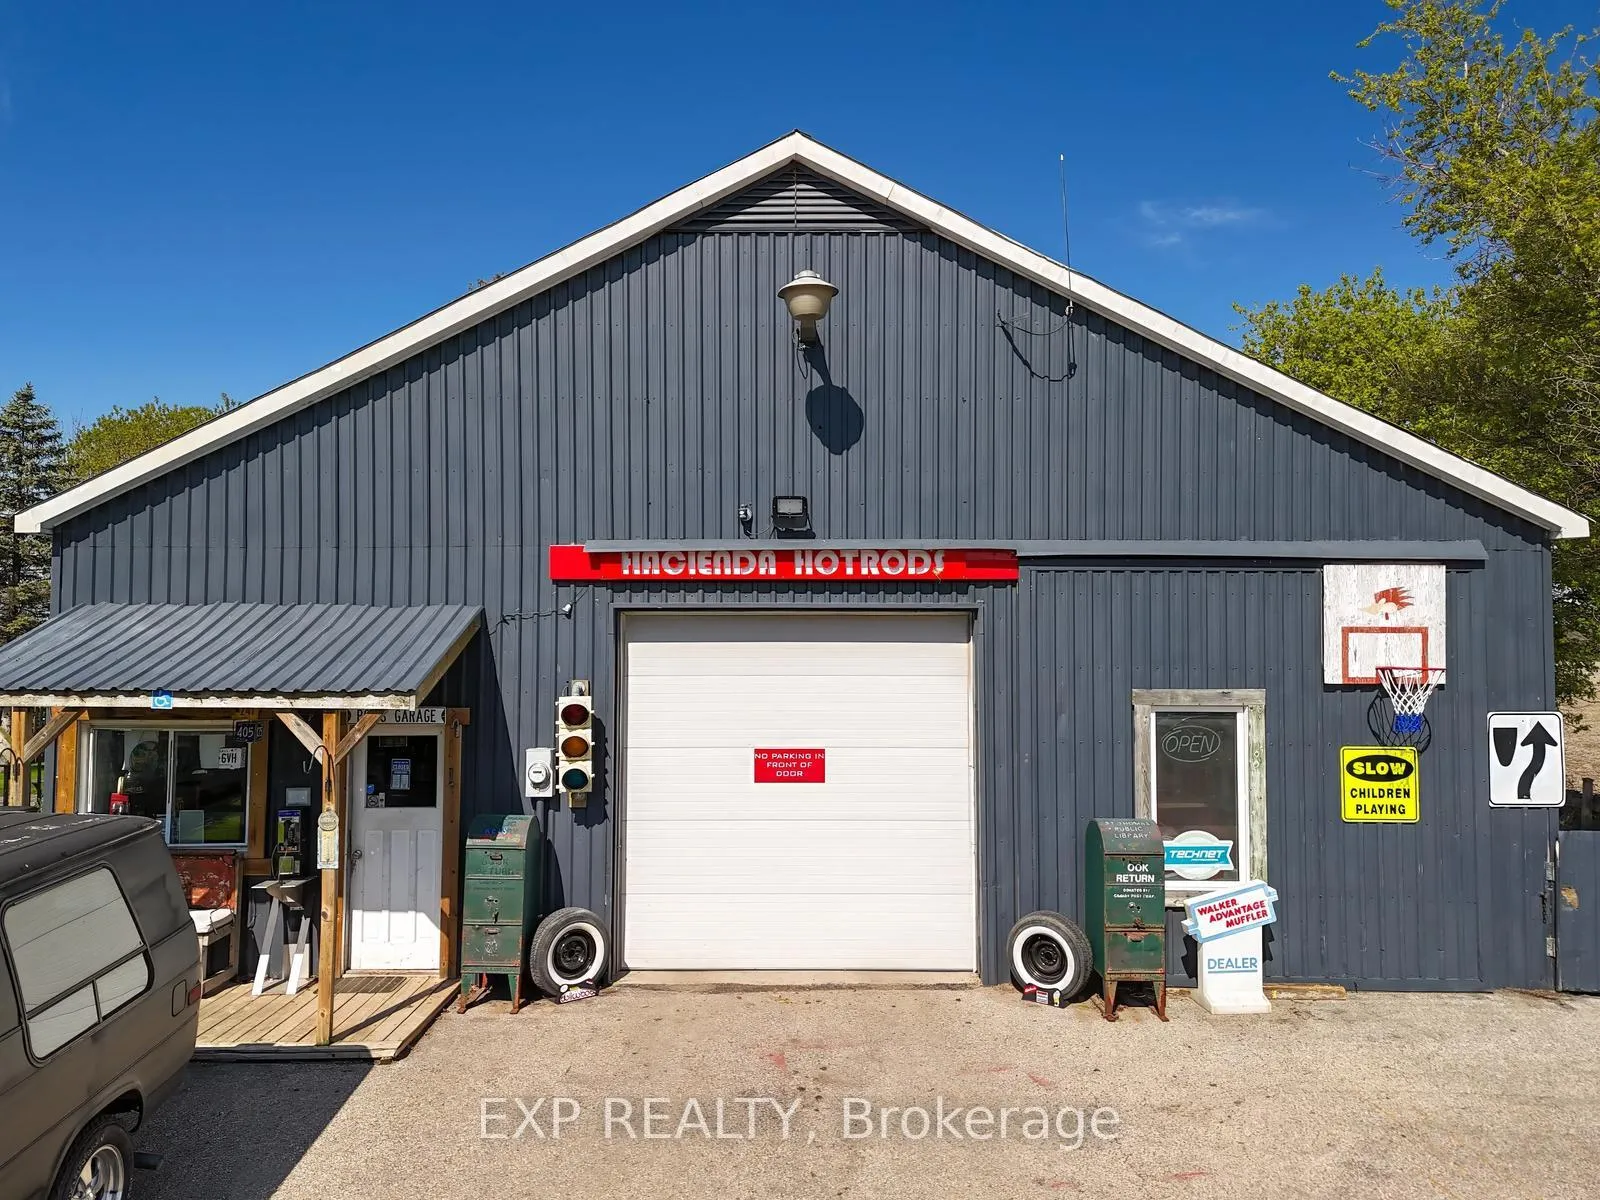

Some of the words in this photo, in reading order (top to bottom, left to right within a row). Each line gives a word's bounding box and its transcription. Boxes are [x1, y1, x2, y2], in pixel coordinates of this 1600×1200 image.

[621, 550, 776, 575] HACIENDA
[794, 550, 945, 575] HOTRODS
[394, 709, 436, 723] GARAGE
[1165, 735, 1216, 753] OPEN
[1352, 761, 1407, 776] SLOW
[1350, 787, 1411, 799] CHILDREN
[1355, 803, 1406, 815] PLAYING
[1116, 874, 1155, 883] RETURN
[1197, 898, 1237, 916] WALKER
[1209, 900, 1266, 923] ADVANTAGE
[1225, 909, 1268, 928] MUFFLER
[1207, 957, 1258, 970] DEALER
